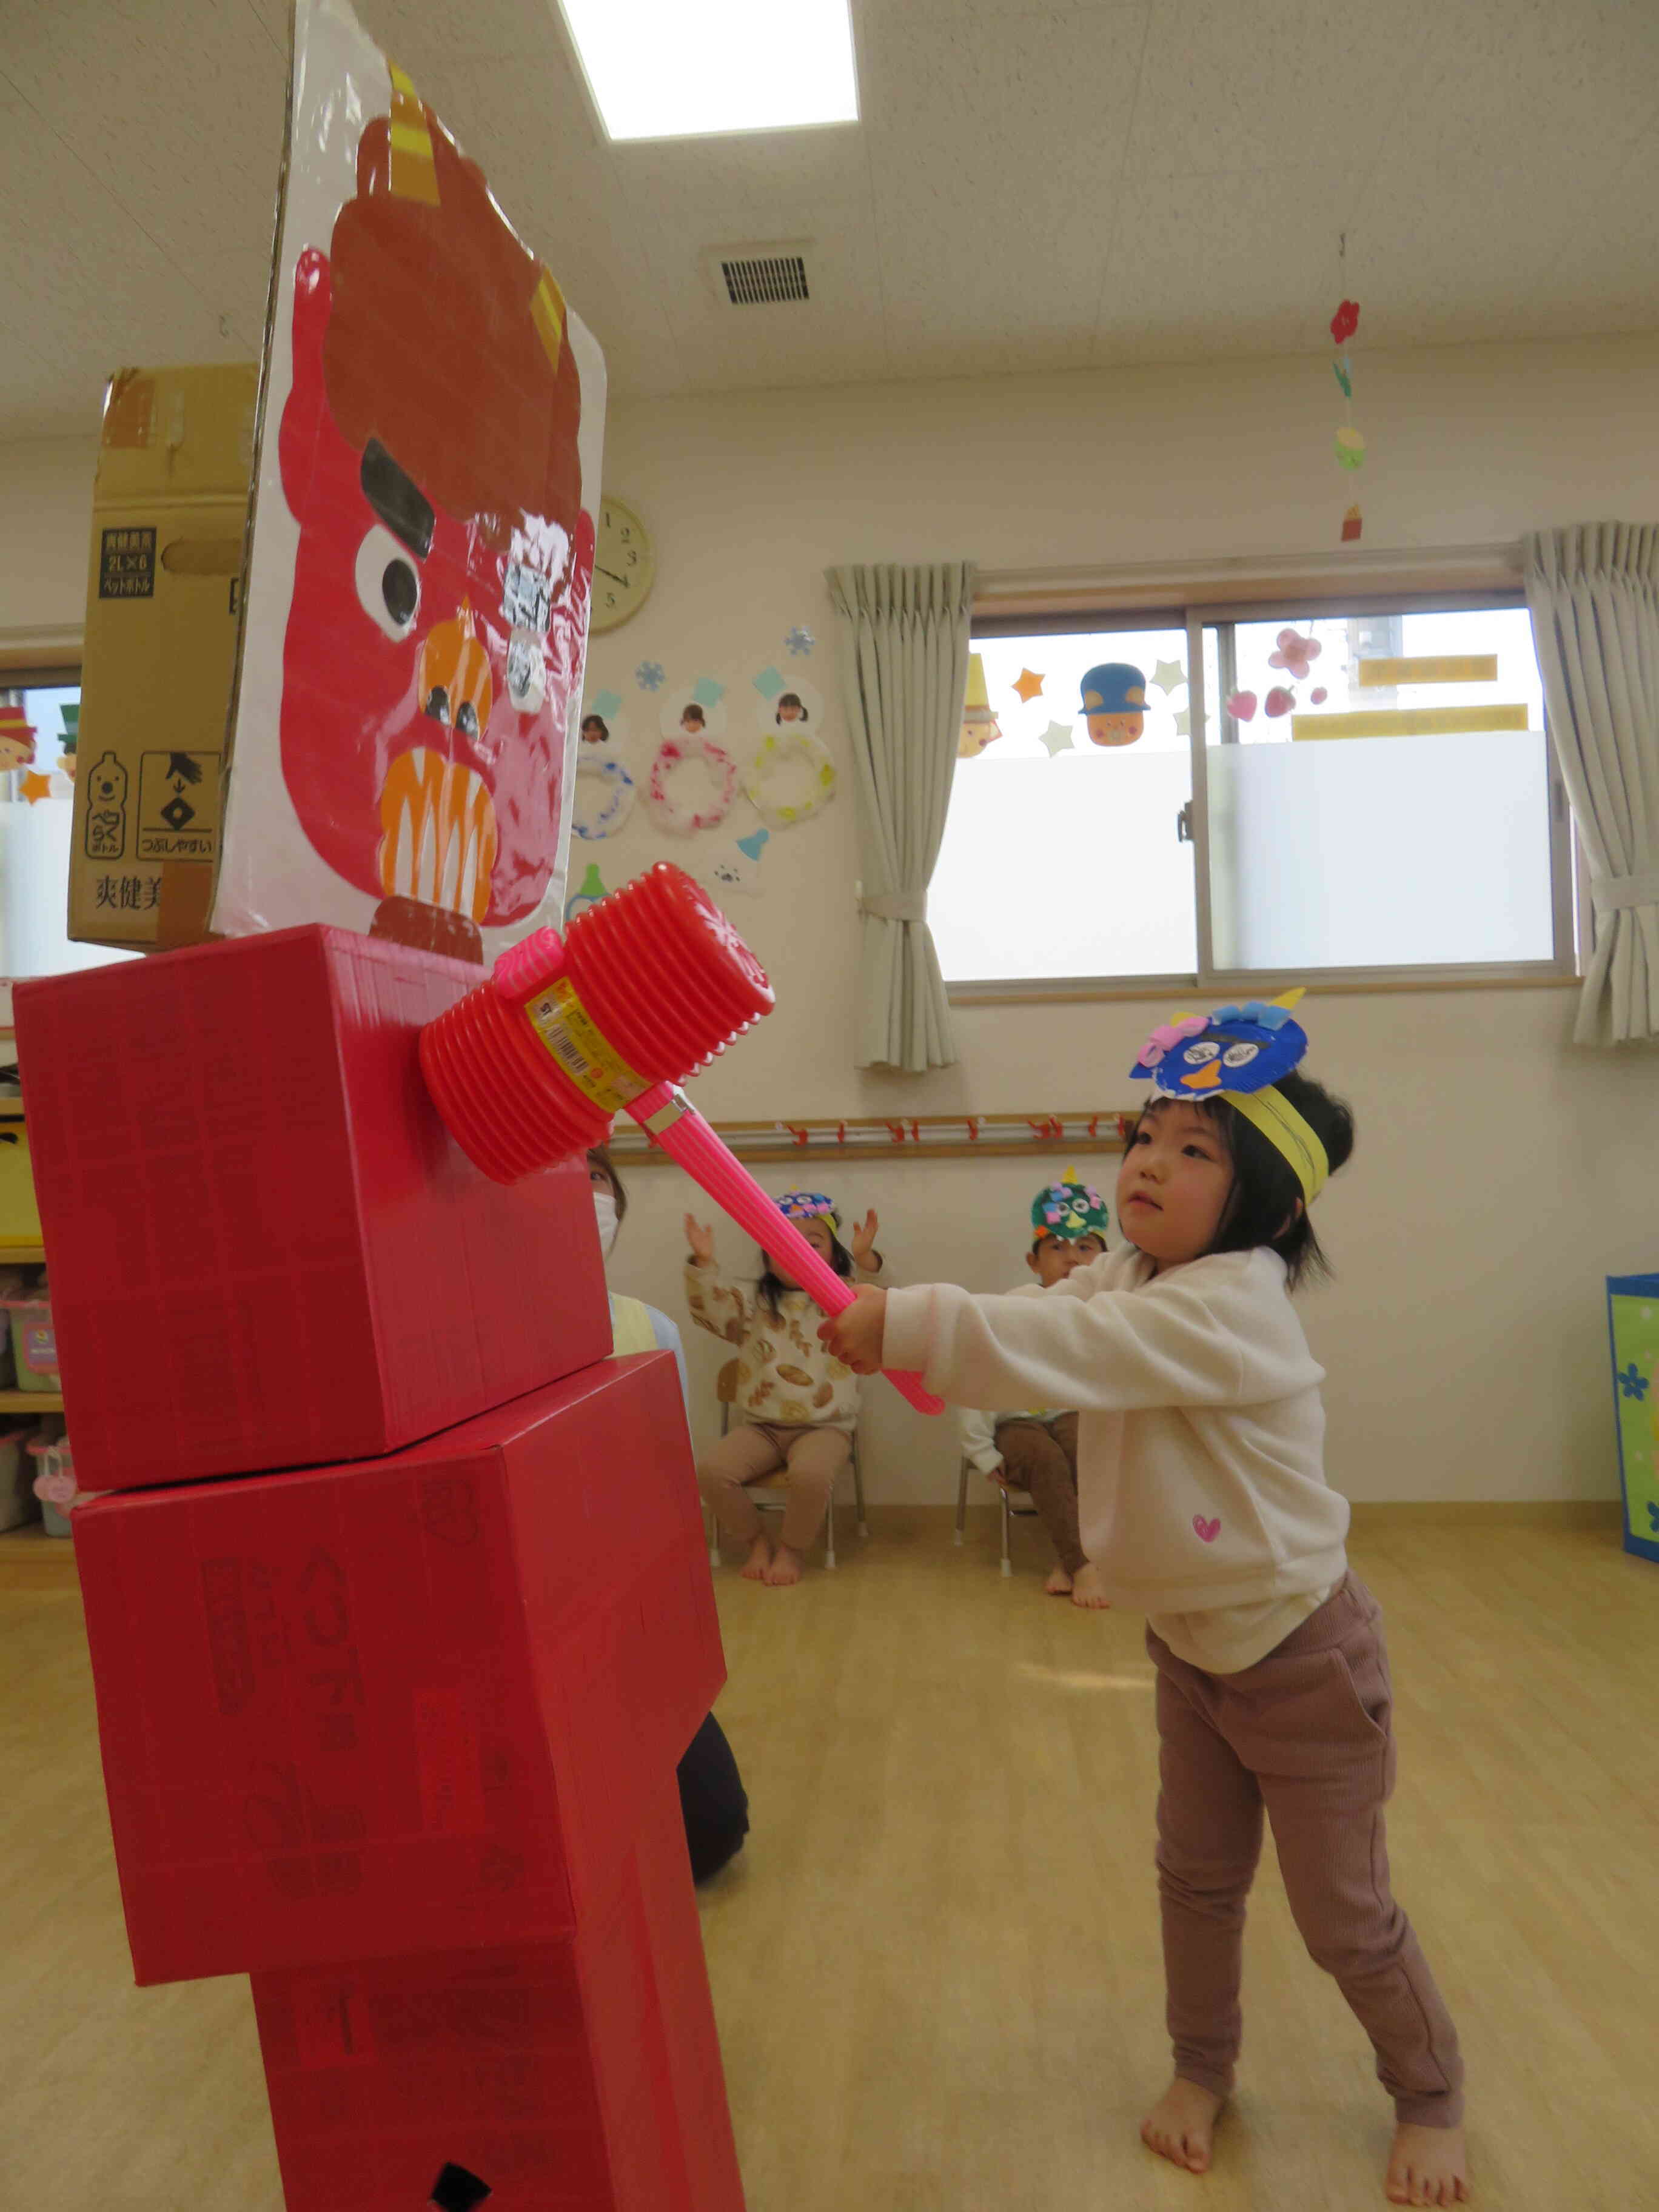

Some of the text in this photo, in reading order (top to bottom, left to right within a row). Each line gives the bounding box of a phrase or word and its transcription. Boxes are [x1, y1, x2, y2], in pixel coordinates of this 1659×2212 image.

[606, 512, 611, 529] 1
[626, 550, 637, 567] 3
[141, 838, 212, 854] つぶしやすい
[96, 875, 162, 910] 爽健美
